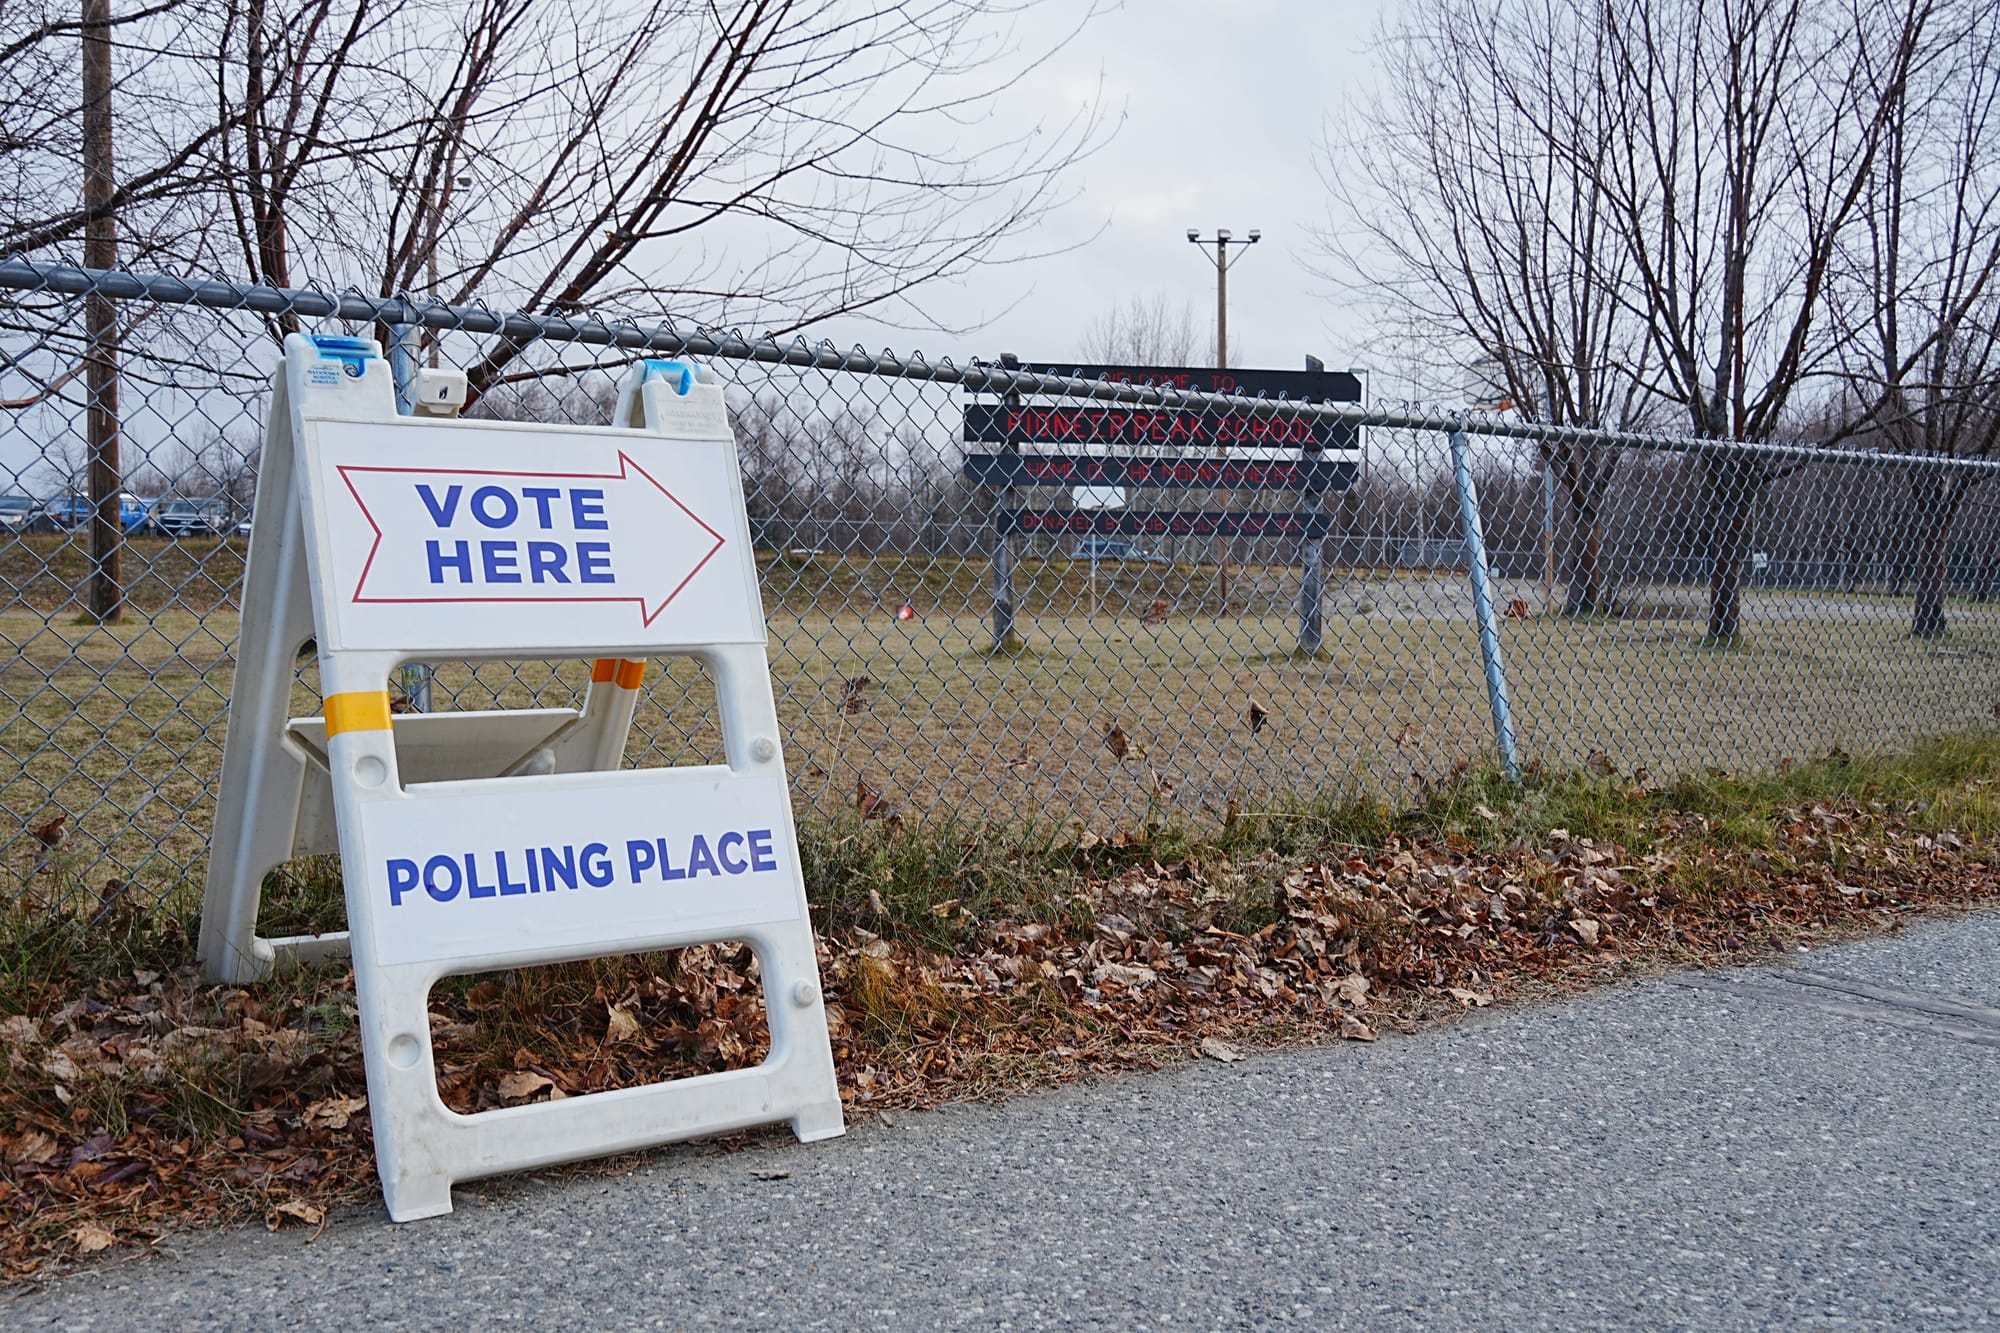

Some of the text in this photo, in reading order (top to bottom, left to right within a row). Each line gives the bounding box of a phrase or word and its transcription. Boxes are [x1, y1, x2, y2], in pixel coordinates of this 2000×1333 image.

[1210, 375, 1236, 392] TO
[1006, 411, 1317, 444] PIONEER PEAK SCHOOL
[1027, 462, 1078, 481] HOME
[1087, 463, 1109, 481] OF
[414, 484, 609, 530] VOTE
[1023, 515, 1095, 531] DONATED
[1105, 518, 1123, 531] B
[425, 539, 616, 584] HERE
[386, 829, 777, 907] POLLING PLACE
